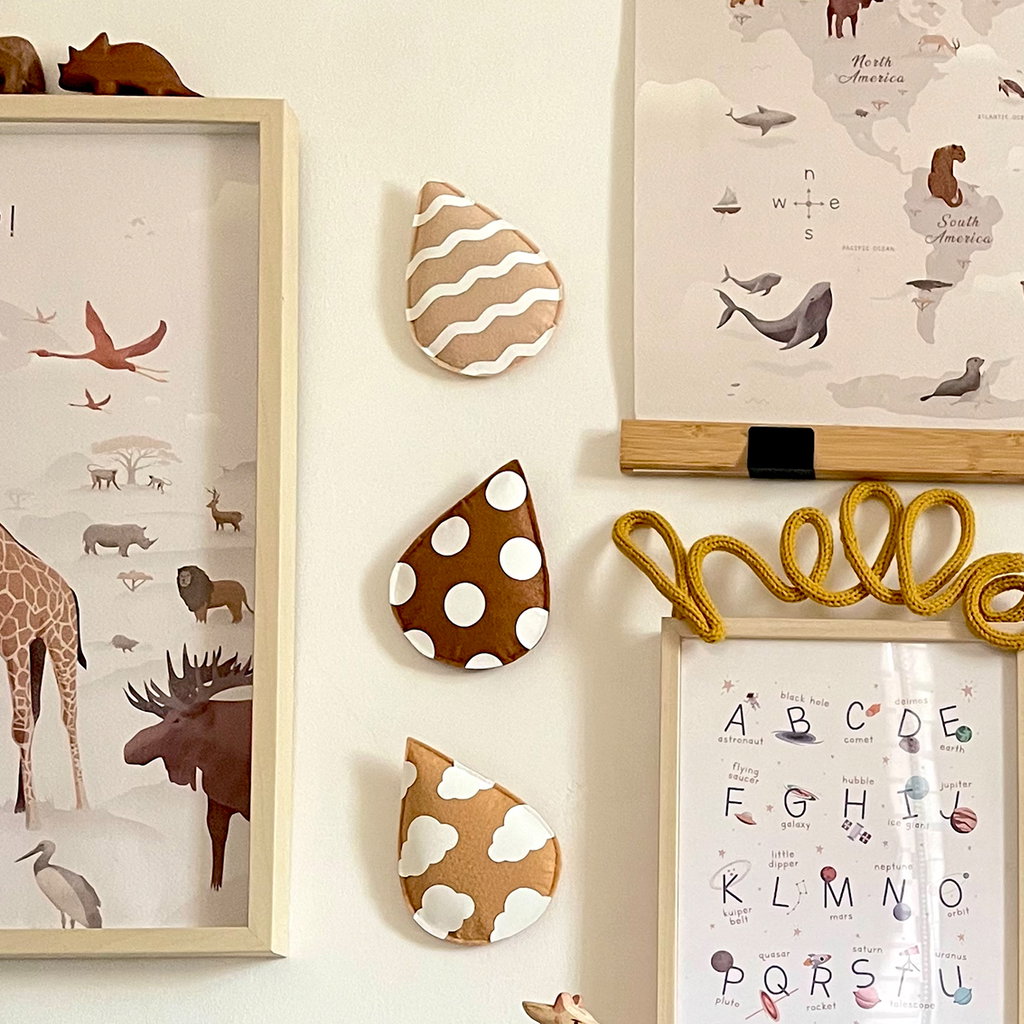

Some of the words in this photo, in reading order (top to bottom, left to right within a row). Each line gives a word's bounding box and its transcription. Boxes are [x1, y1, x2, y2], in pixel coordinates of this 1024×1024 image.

[851, 54, 892, 68] North
[838, 70, 904, 84] America
[804, 169, 815, 180] n
[772, 198, 787, 209] w
[829, 198, 840, 210] e
[937, 213, 979, 228] South
[804, 228, 814, 240] s
[925, 230, 993, 244] America
[780, 691, 806, 705] black
[810, 696, 830, 708] hole
[724, 704, 746, 736] A
[787, 706, 811, 734] B
[846, 701, 865, 730] C
[898, 708, 921, 737] D
[940, 706, 959, 737] E
[718, 736, 764, 746] astronaut
[844, 736, 873, 744] comet
[940, 744, 965, 754] earth
[732, 761, 759, 777] flying
[728, 772, 759, 785] saucer
[842, 776, 874, 786] hubble
[939, 780, 972, 791] jupiter
[725, 787, 744, 816] F
[784, 788, 807, 818] G
[844, 788, 866, 819] H
[897, 788, 918, 819] I
[940, 791, 959, 820] J
[781, 820, 811, 831] galaxy
[771, 850, 795, 859] little
[768, 859, 799, 869] dipper
[874, 862, 913, 872] neptune
[723, 874, 743, 904] K
[772, 876, 789, 907] L
[824, 877, 854, 908] M
[883, 877, 906, 906] N
[939, 879, 963, 908] O
[723, 907, 752, 918] kuiper
[830, 912, 853, 921] mars
[947, 908, 970, 918] orbit
[729, 916, 748, 926] belt
[852, 945, 883, 954] saturn
[759, 950, 790, 961] quasar
[934, 951, 967, 961] uranus
[722, 966, 744, 995] P
[764, 965, 790, 996] Q
[811, 966, 832, 997] R
[852, 959, 875, 988] S
[939, 966, 962, 997] U
[715, 996, 740, 1008] pluto
[806, 1002, 837, 1011] rocket
